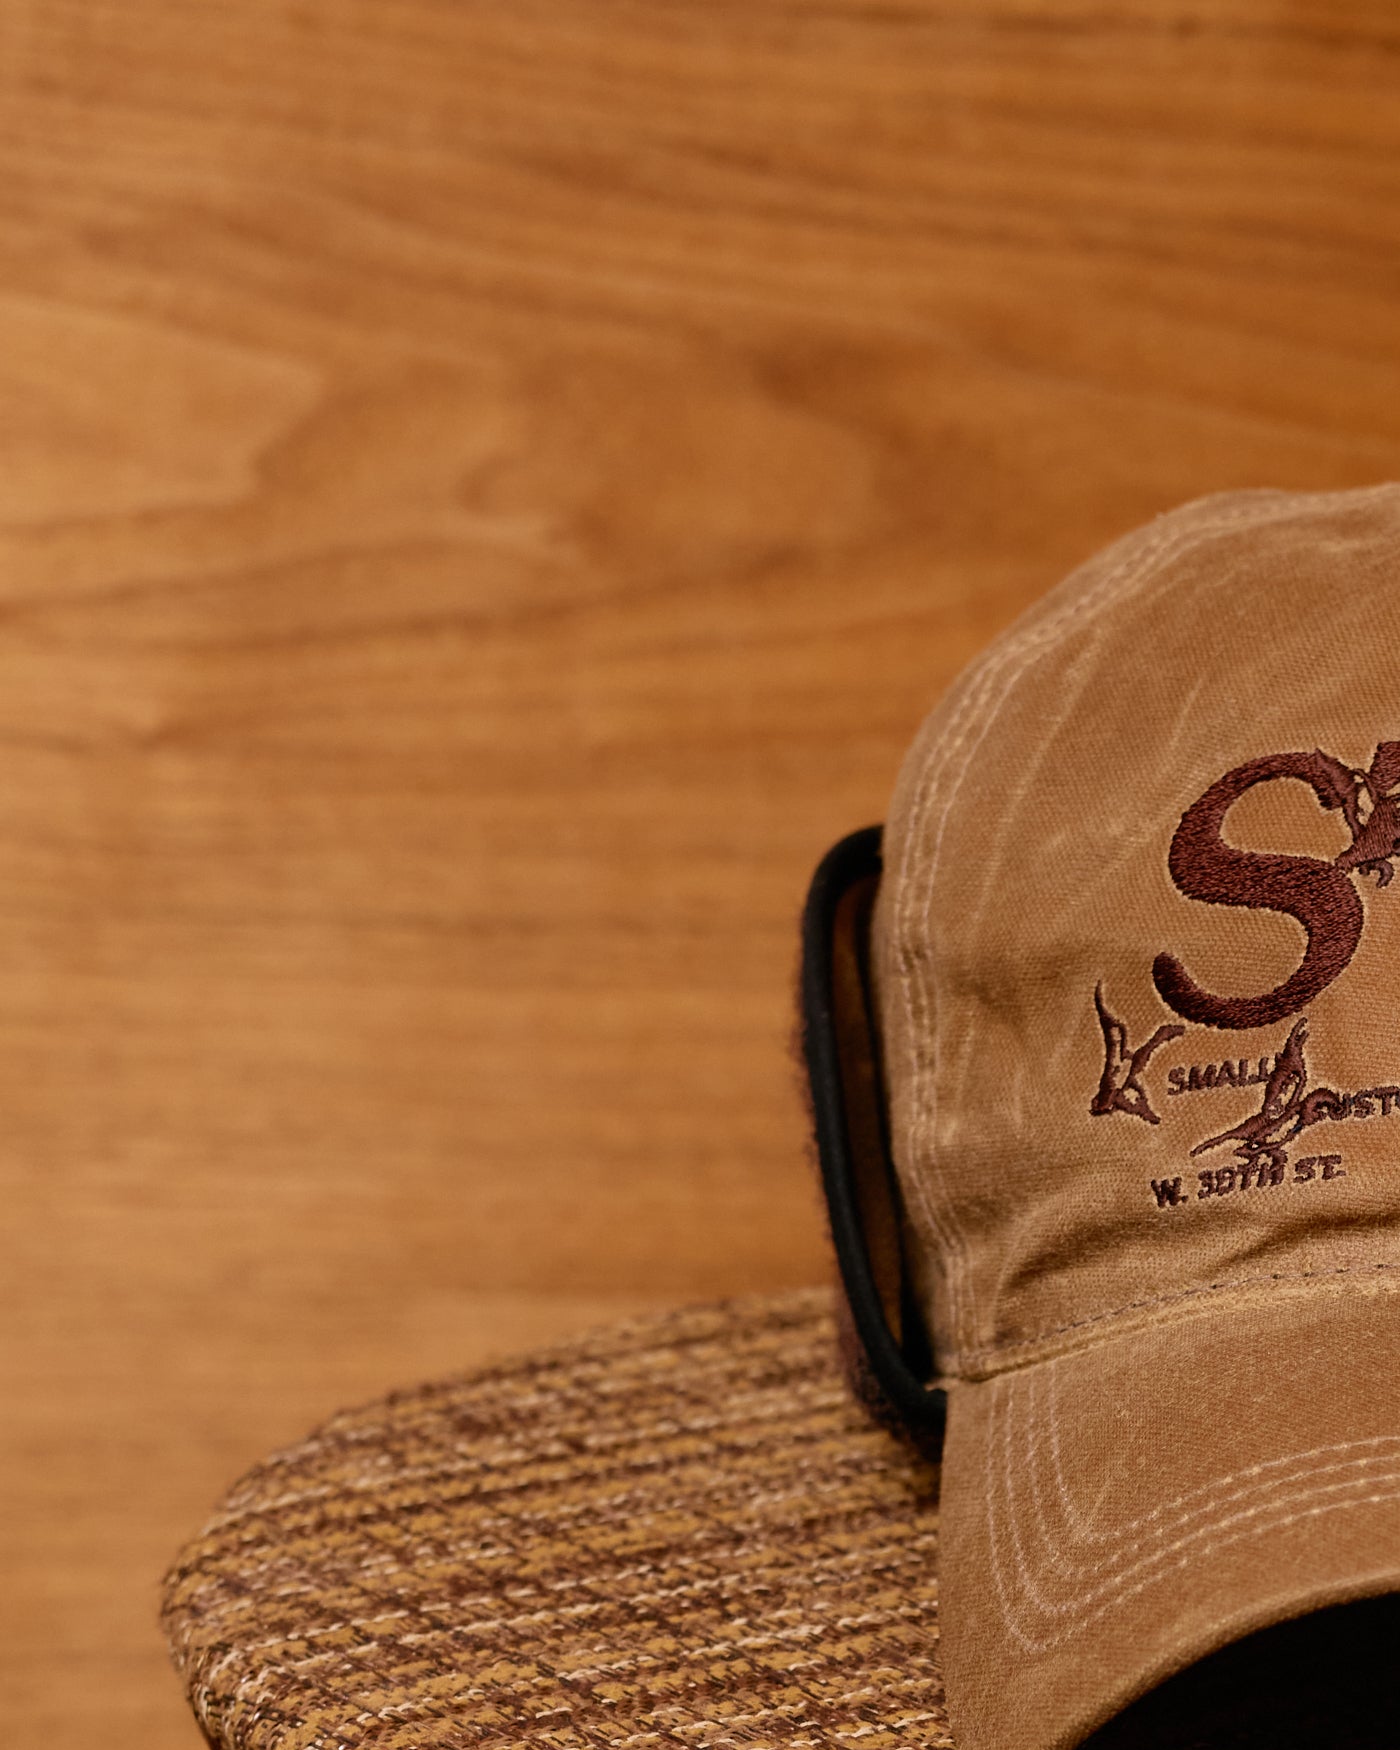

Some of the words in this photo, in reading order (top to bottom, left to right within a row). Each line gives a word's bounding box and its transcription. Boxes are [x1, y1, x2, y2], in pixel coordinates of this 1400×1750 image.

[1167, 1056, 1275, 1095] SMALL
[1151, 1177, 1189, 1208] W.
[1293, 1154, 1346, 1183] ST.
